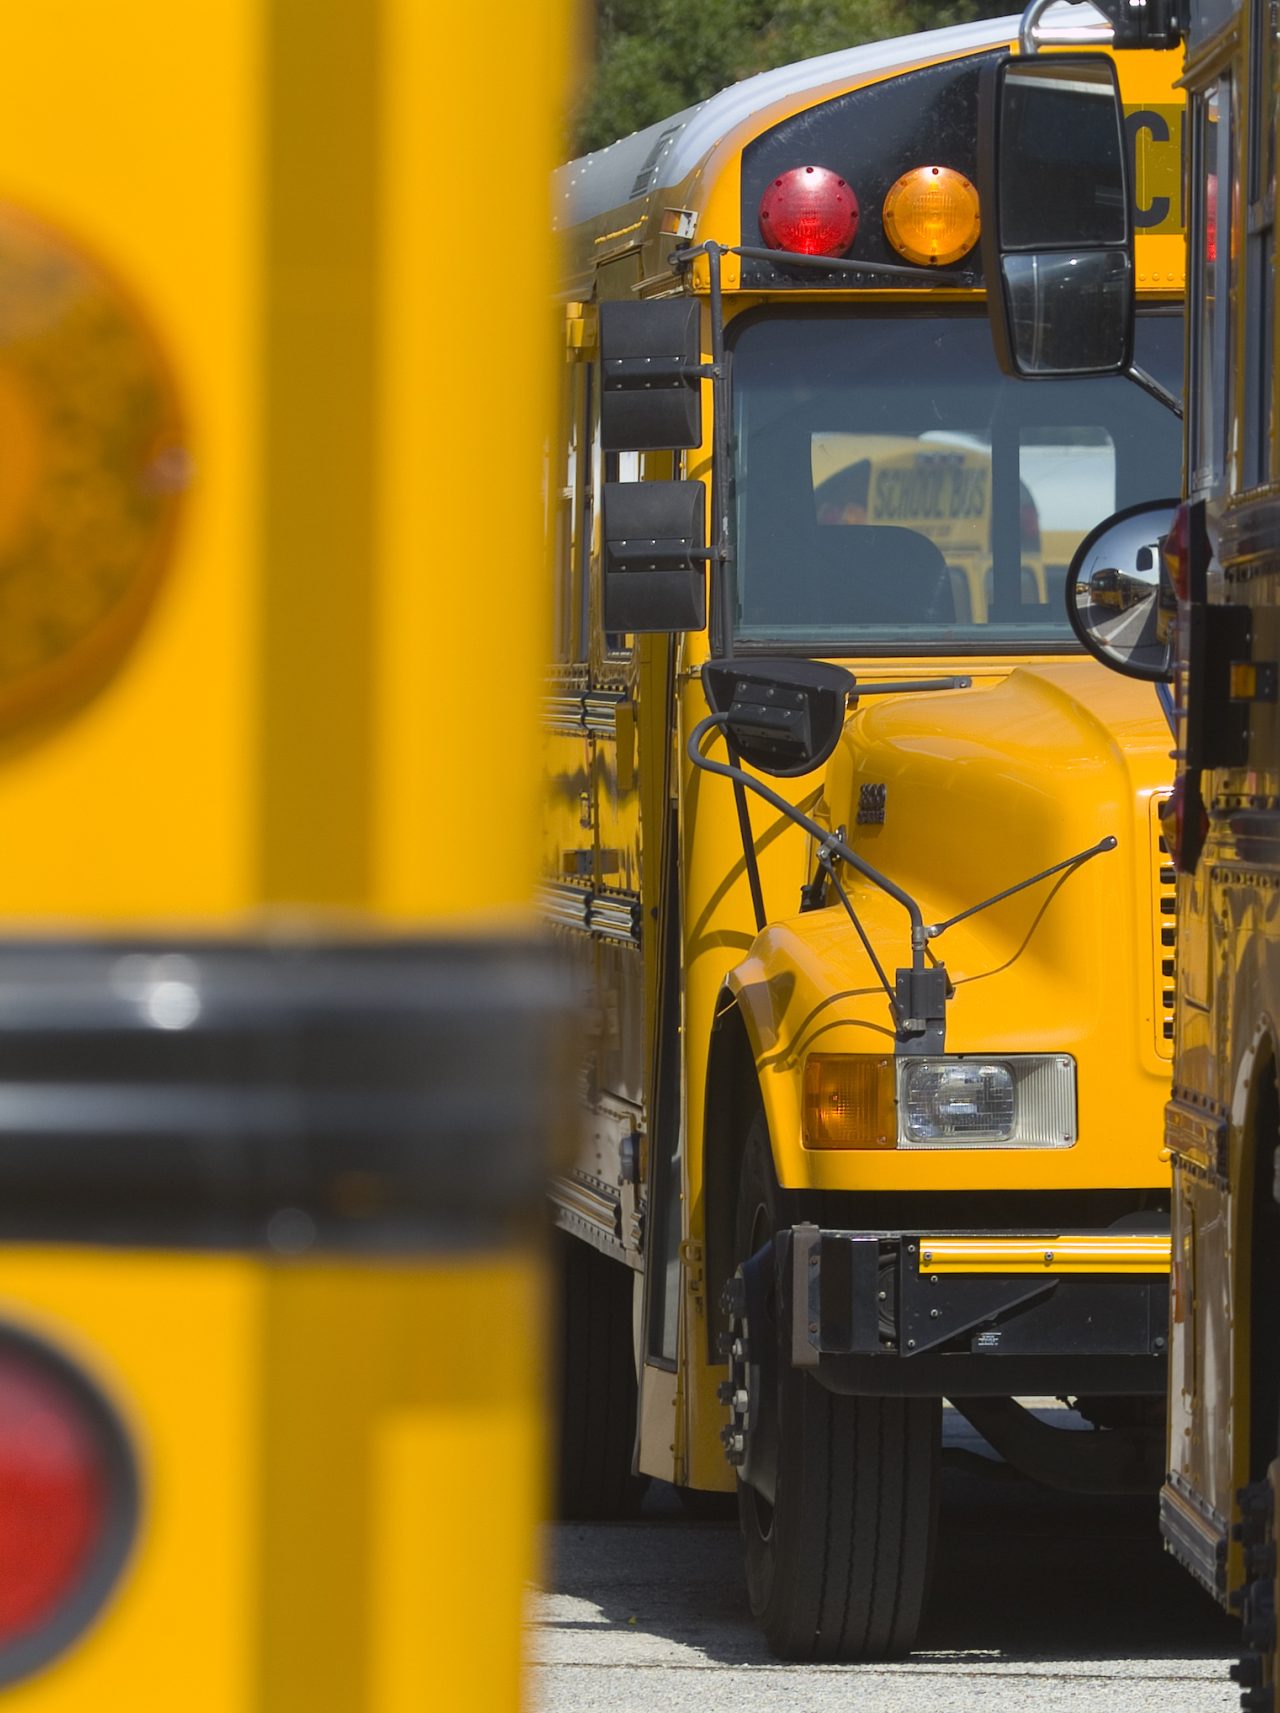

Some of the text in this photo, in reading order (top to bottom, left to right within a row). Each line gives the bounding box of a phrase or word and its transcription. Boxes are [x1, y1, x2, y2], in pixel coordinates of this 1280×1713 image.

[1124, 110, 1186, 228] C
[874, 465, 985, 519] SCHOOL BUS
